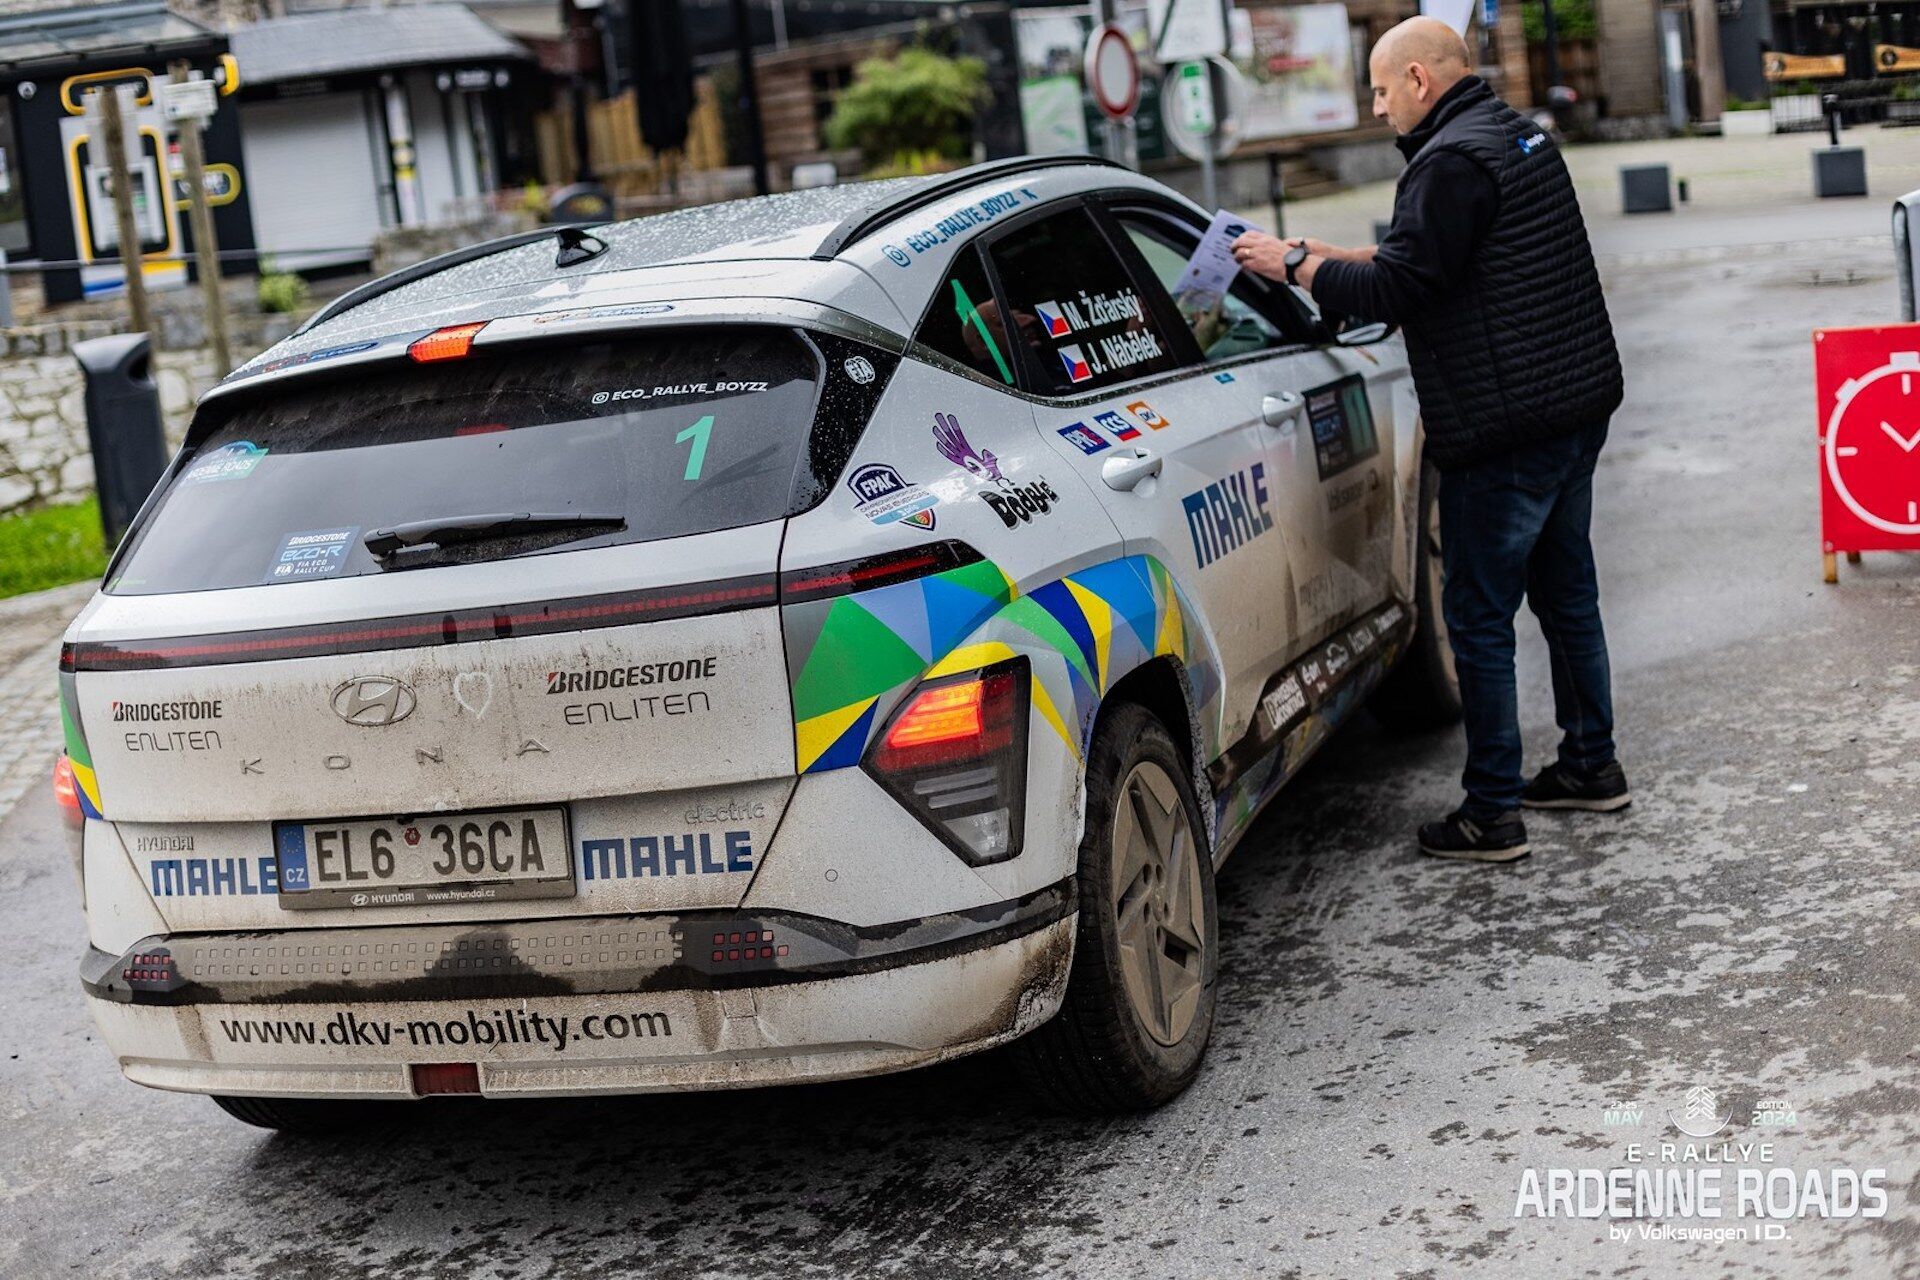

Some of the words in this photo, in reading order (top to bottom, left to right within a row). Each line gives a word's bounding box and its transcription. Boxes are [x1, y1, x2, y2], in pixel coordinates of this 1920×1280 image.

[905, 192, 1020, 253] ECO_RALLYE_BOYZZ
[1062, 302, 1088, 331] M.
[1078, 287, 1145, 327] Žďárský
[951, 279, 1014, 385] 1
[1087, 342, 1108, 374] J.
[1100, 327, 1163, 370] Nábělek
[611, 381, 768, 401] ECO_RALLYE_BOYZZ
[1100, 415, 1130, 432] CCS
[675, 415, 715, 480] 1
[860, 472, 897, 497] FPAK
[1181, 462, 1274, 570] MAHLE
[288, 532, 351, 546] BRIDGESTONE
[275, 563, 294, 576] FIA
[319, 565, 335, 573] CUP
[547, 657, 717, 695] BRIDGESTONE
[112, 700, 222, 722] BRIDGESTONE
[564, 691, 710, 725] ENLITEN
[125, 730, 222, 751] ENLITEN
[684, 802, 765, 825] electric
[137, 836, 194, 851] HYUNDAI
[314, 828, 395, 882] EL6
[430, 819, 545, 876] 36CA
[582, 831, 753, 880] MAHLE
[151, 857, 278, 896] MAHLE
[285, 868, 306, 883] CZ
[371, 892, 415, 904] HYUNDAI
[426, 888, 496, 901] www.hyundai.cz
[220, 1010, 672, 1051] www.dkv-mobility.com
